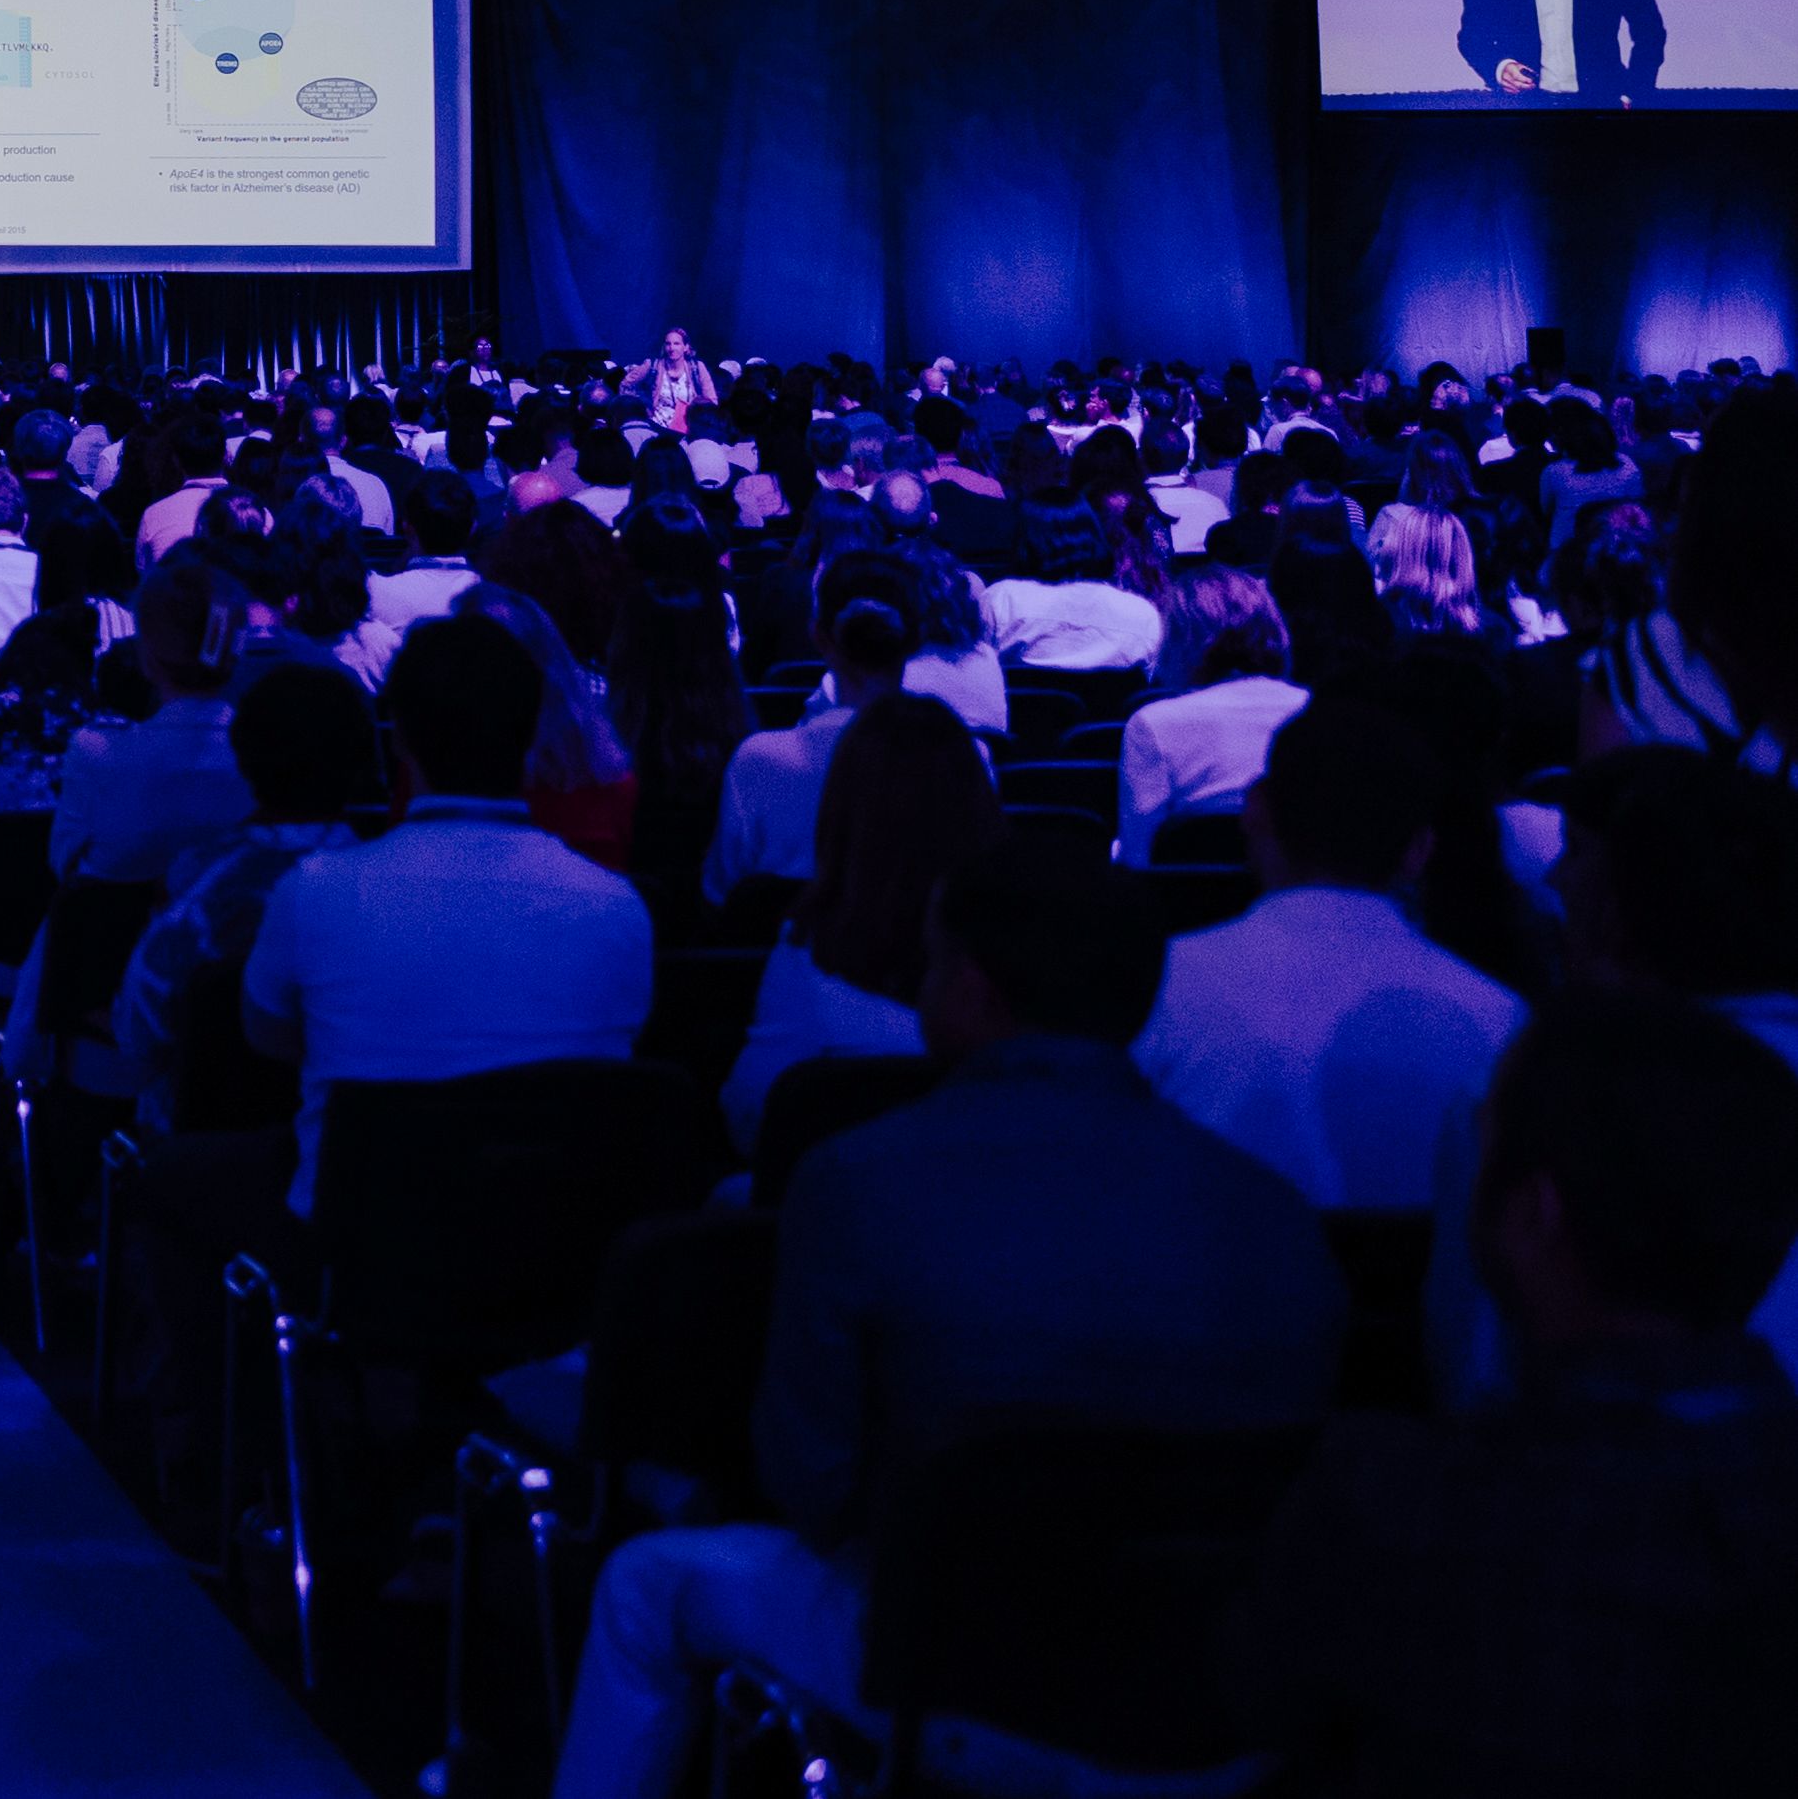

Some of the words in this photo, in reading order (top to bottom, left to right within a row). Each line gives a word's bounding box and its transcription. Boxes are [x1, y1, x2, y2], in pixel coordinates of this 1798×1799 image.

[3, 145, 56, 157] production
[44, 174, 75, 182] cause
[169, 168, 204, 180] ApoE4
[206, 169, 216, 179] is
[218, 170, 234, 179] the
[236, 170, 284, 181] strongest
[286, 171, 330, 179] common
[332, 169, 370, 181] genetic
[169, 183, 188, 192] risk
[190, 183, 219, 193] factor
[222, 183, 231, 192] in
[294, 183, 334, 193] disease
[336, 183, 361, 195] (AD)
